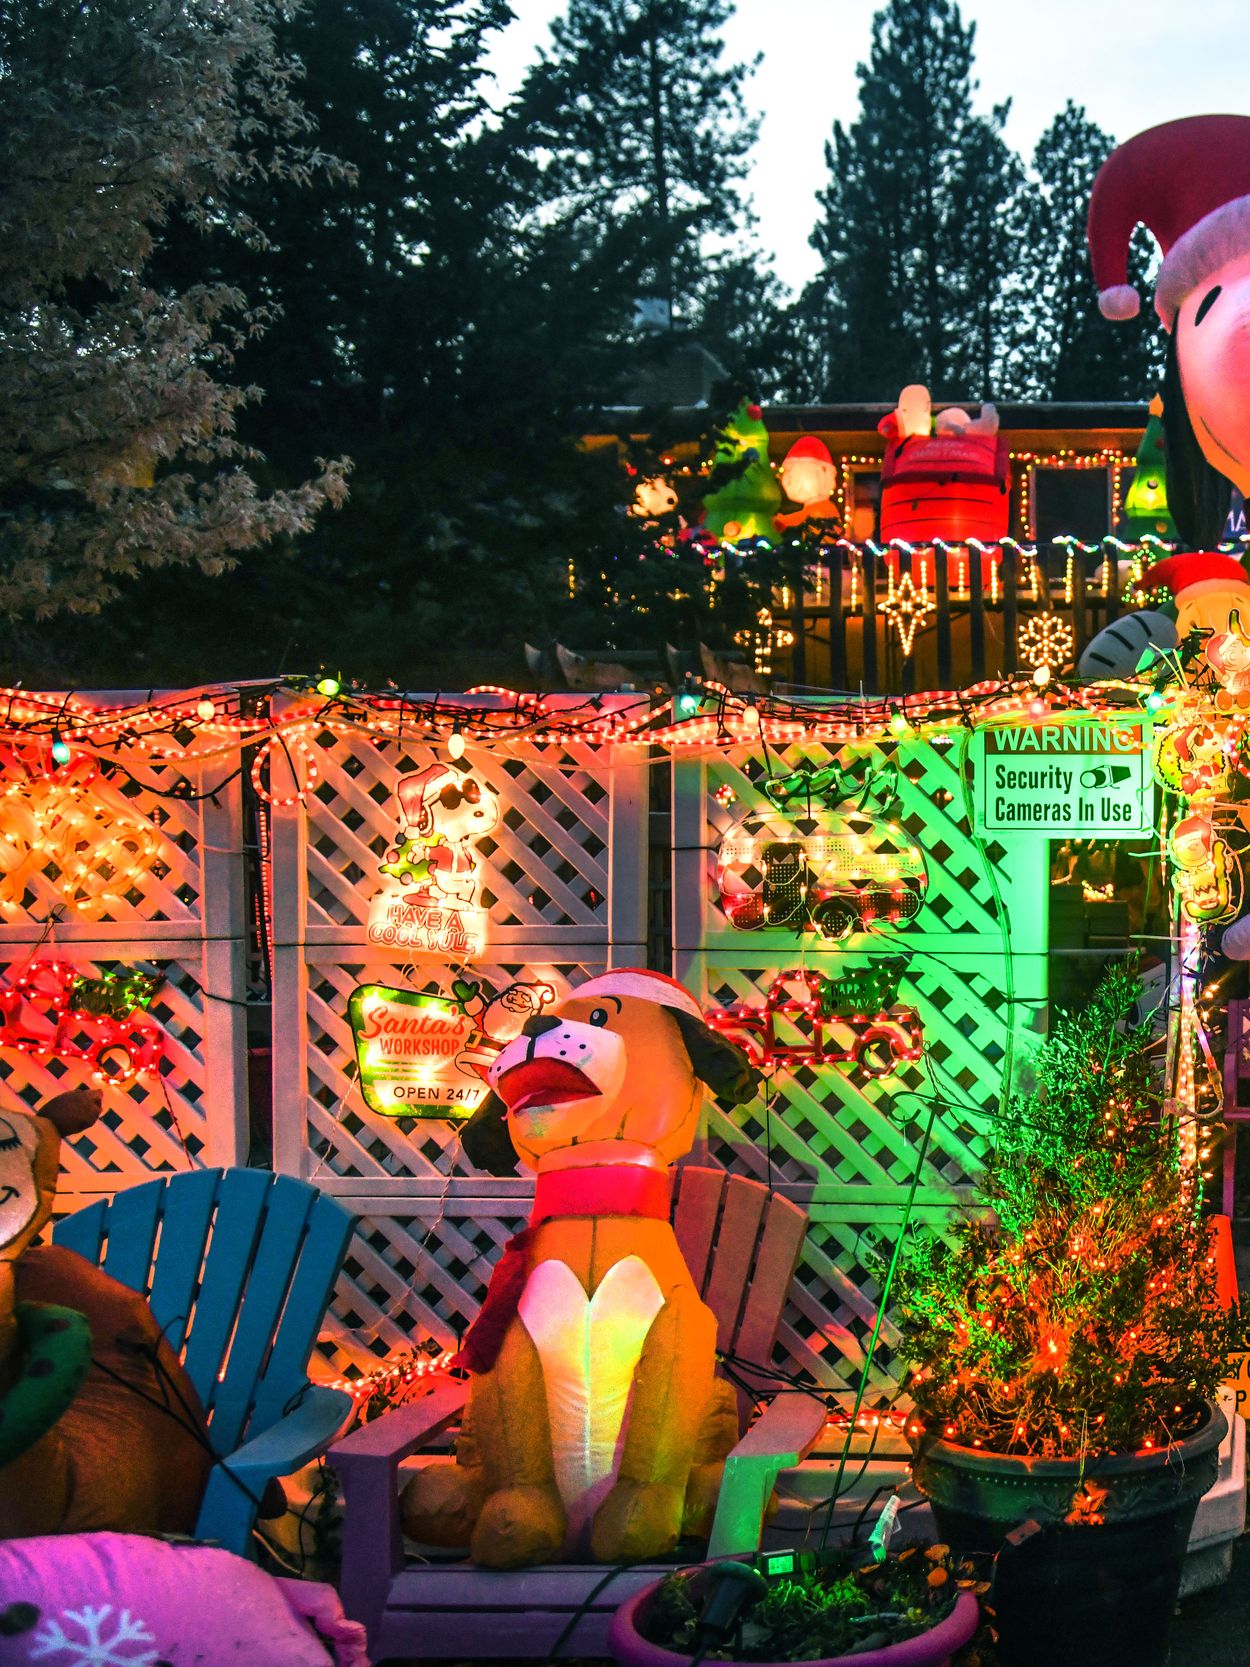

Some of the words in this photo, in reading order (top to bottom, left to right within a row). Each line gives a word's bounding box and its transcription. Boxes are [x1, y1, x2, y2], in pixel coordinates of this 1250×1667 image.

[993, 726, 1135, 752] WARNING
[995, 764, 1073, 794] Security
[995, 797, 1072, 821] Cameras
[1079, 797, 1094, 821] In
[1101, 797, 1132, 821] Use
[387, 905, 442, 930] HAVE
[445, 911, 465, 933] A
[369, 922, 423, 947] COOL
[427, 928, 478, 955] YULE
[359, 1004, 466, 1039] Santa's
[380, 1038, 460, 1056] WORKSHOP
[393, 1086, 440, 1100] OPEN
[446, 1088, 480, 1102] 24/7
